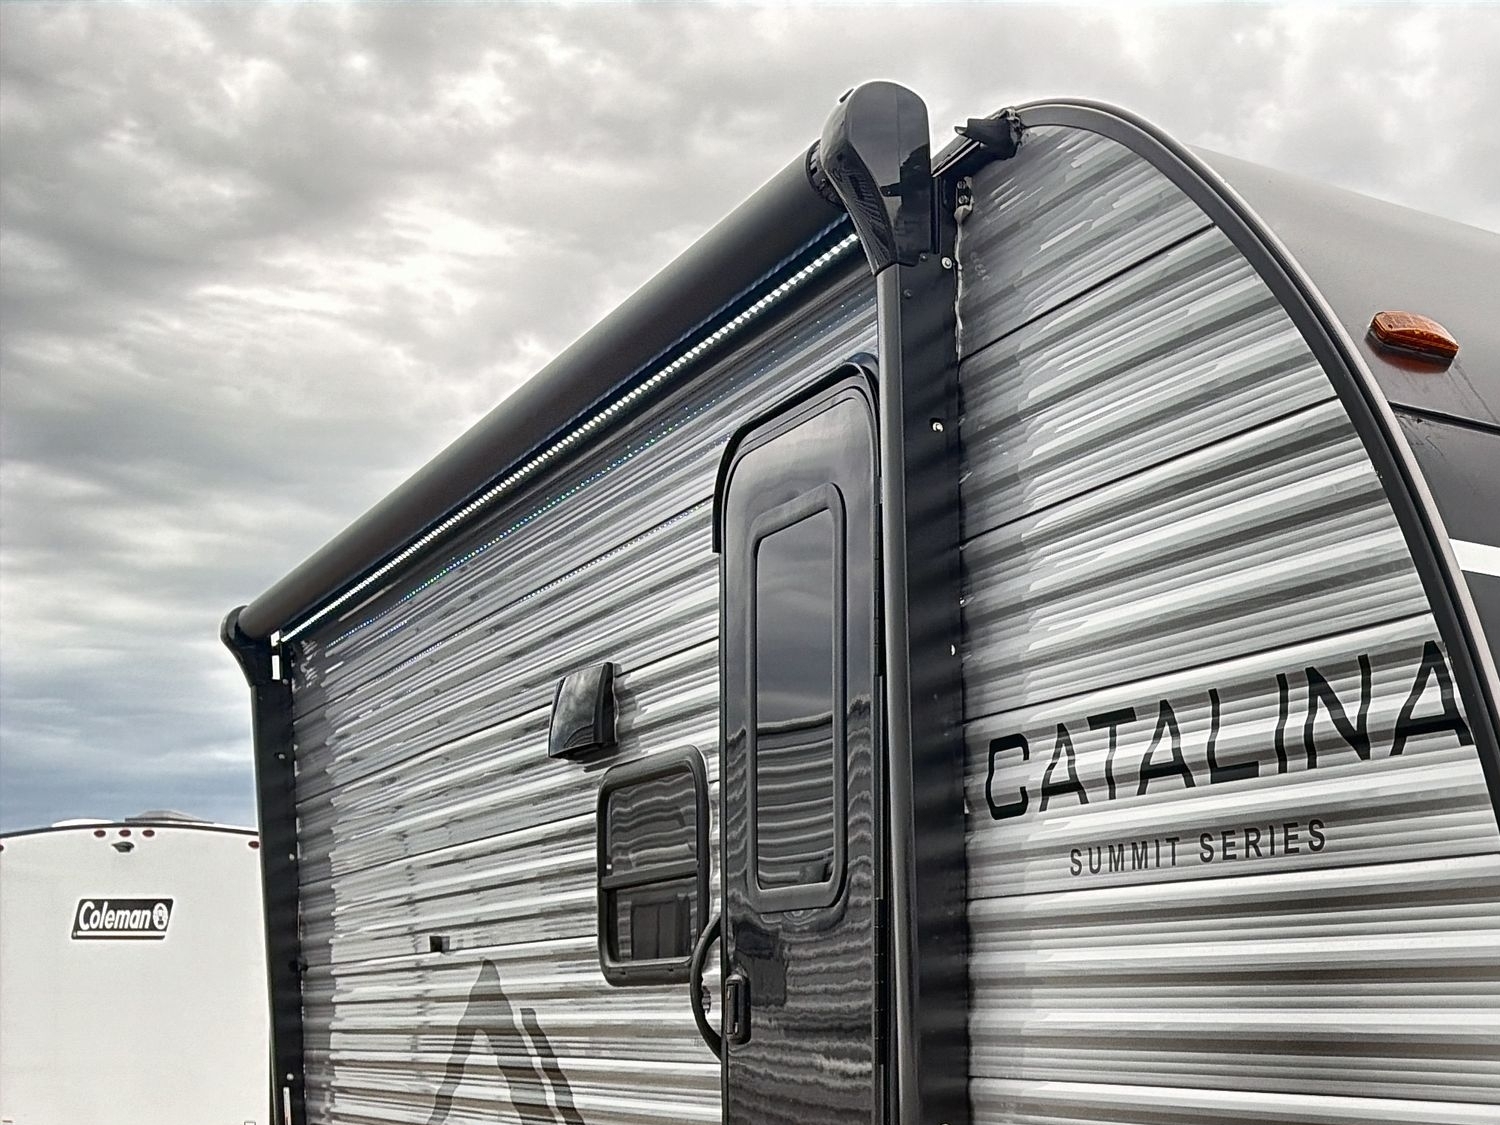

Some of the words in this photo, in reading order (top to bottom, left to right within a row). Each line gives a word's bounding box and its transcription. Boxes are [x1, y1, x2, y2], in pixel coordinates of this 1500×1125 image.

[985, 640, 1474, 820] CATALINA
[1070, 836, 1180, 876] SUMMIT
[1200, 819, 1326, 863] SERIES
[79, 901, 151, 930] Coleman
